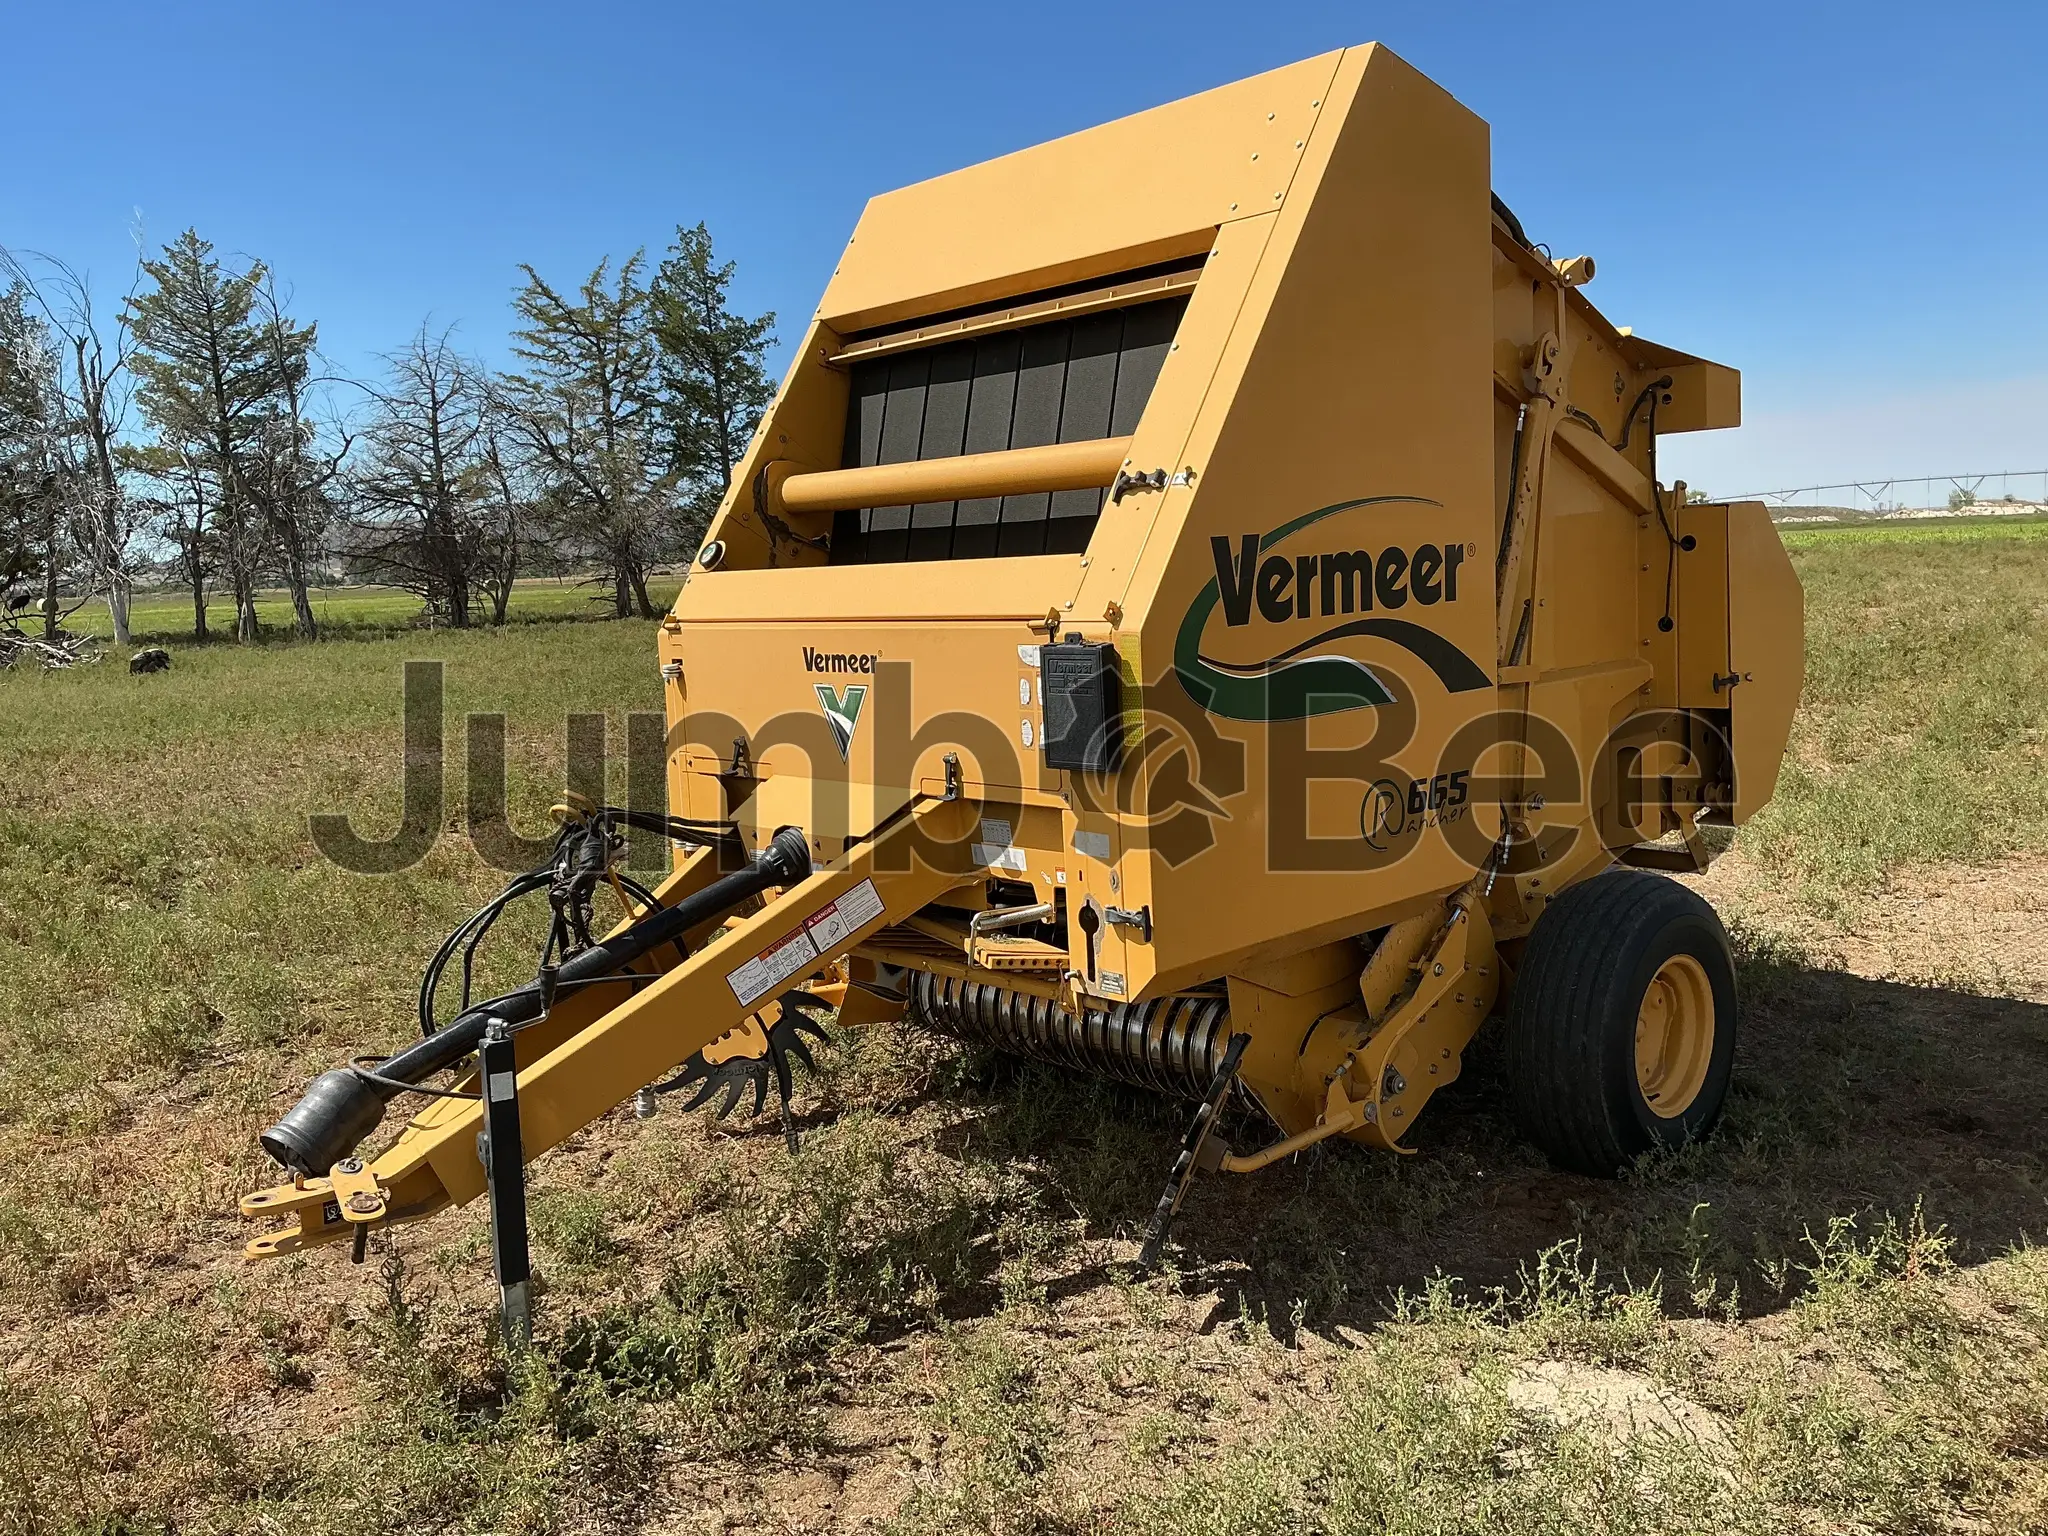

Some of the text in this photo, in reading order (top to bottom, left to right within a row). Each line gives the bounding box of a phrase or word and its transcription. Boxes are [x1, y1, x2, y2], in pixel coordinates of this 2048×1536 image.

[1210, 534, 1464, 627] Vermeer
[802, 646, 877, 674] Vermeer
[1049, 660, 1093, 674] Vermeer
[1407, 770, 1469, 814] 665
[813, 905, 836, 922] DANGER
[773, 927, 805, 951] WARNING
